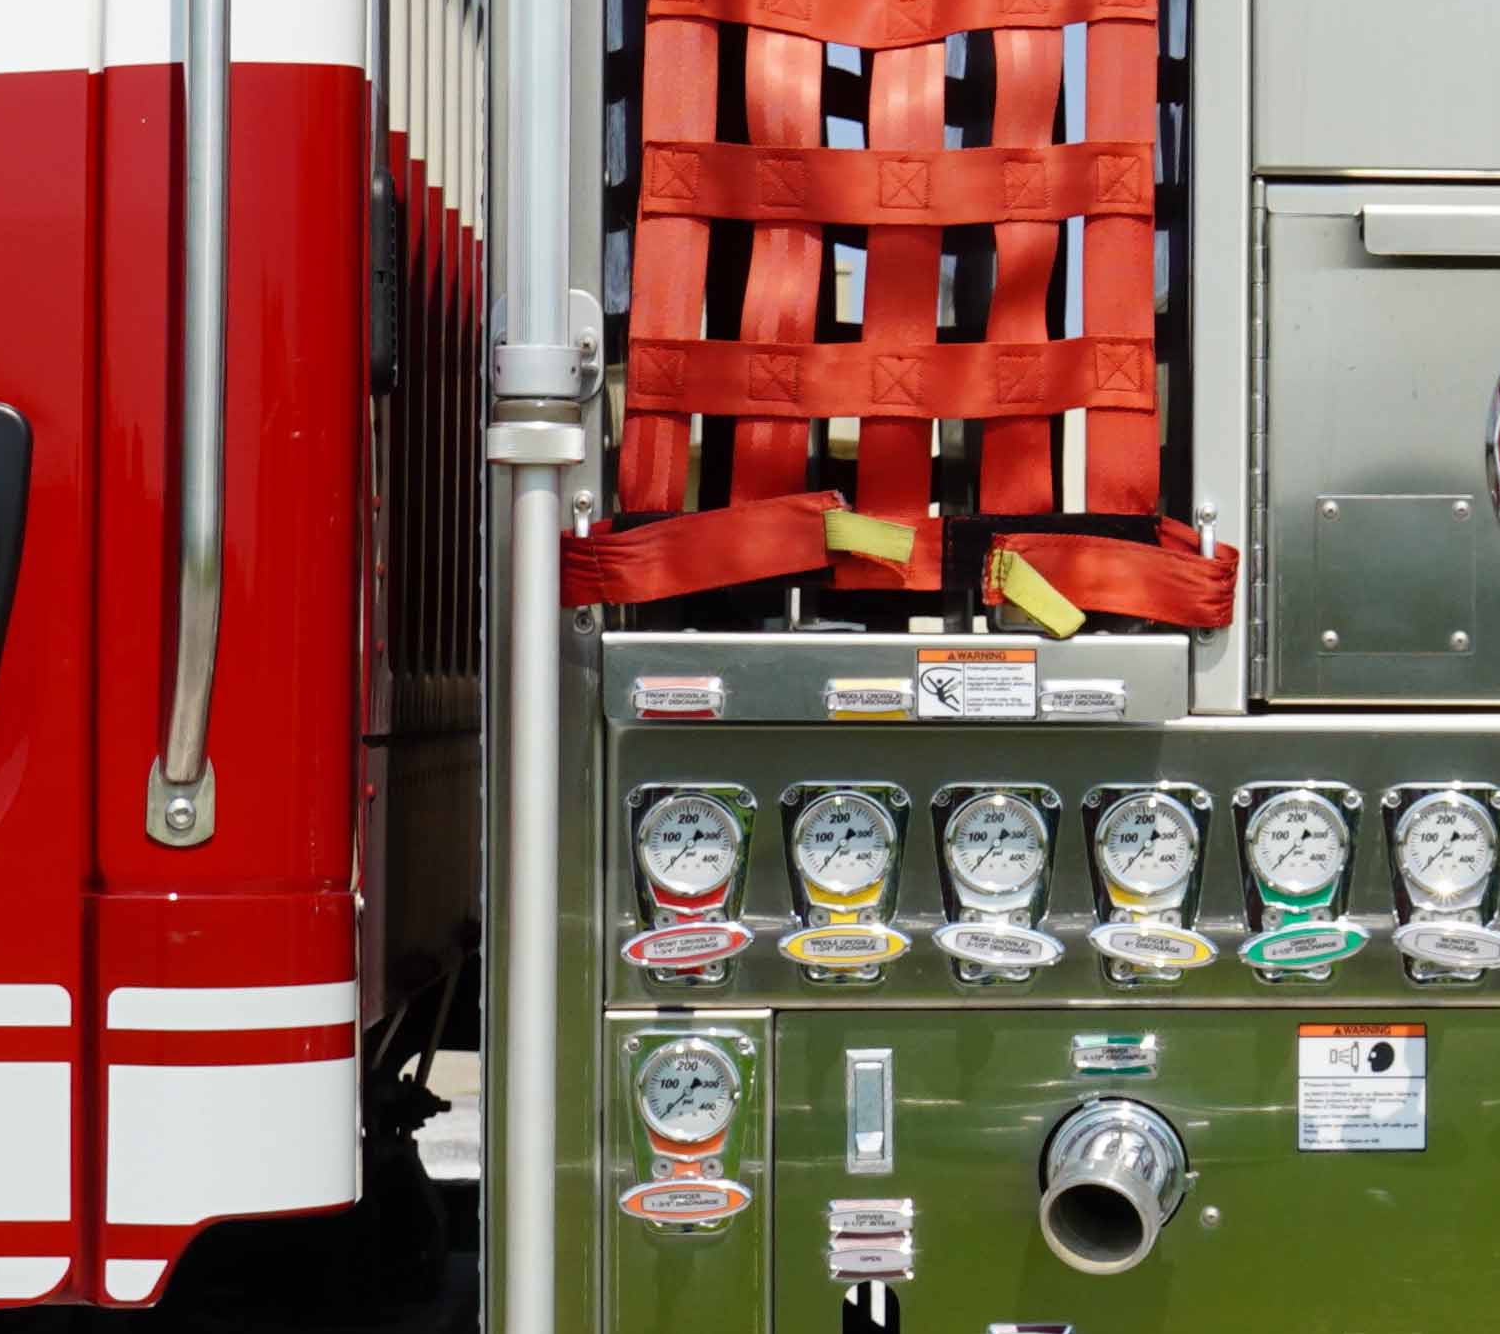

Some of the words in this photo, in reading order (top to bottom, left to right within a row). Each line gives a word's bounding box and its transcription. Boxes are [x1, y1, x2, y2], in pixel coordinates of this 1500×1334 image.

[958, 650, 1006, 660] WARNING
[678, 813, 699, 824] 200
[830, 813, 850, 824] 200
[984, 813, 1004, 823] 200
[1135, 814, 1155, 824] 200
[1287, 813, 1307, 823] 200
[1436, 815, 1456, 825] 200
[663, 832, 681, 842] 100
[815, 832, 834, 842] 100
[969, 832, 987, 842] 100
[1120, 832, 1138, 843] 100
[1271, 831, 1289, 840] 100
[1421, 833, 1439, 842] 100
[856, 852, 872, 860] 400
[1009, 853, 1026, 862] 400
[1160, 854, 1175, 862] 400
[1310, 853, 1326, 861] 400
[1459, 854, 1475, 863] 400
[1344, 1026, 1391, 1035] WARNING
[676, 1061, 698, 1071] 200
[660, 1079, 679, 1088] 100
